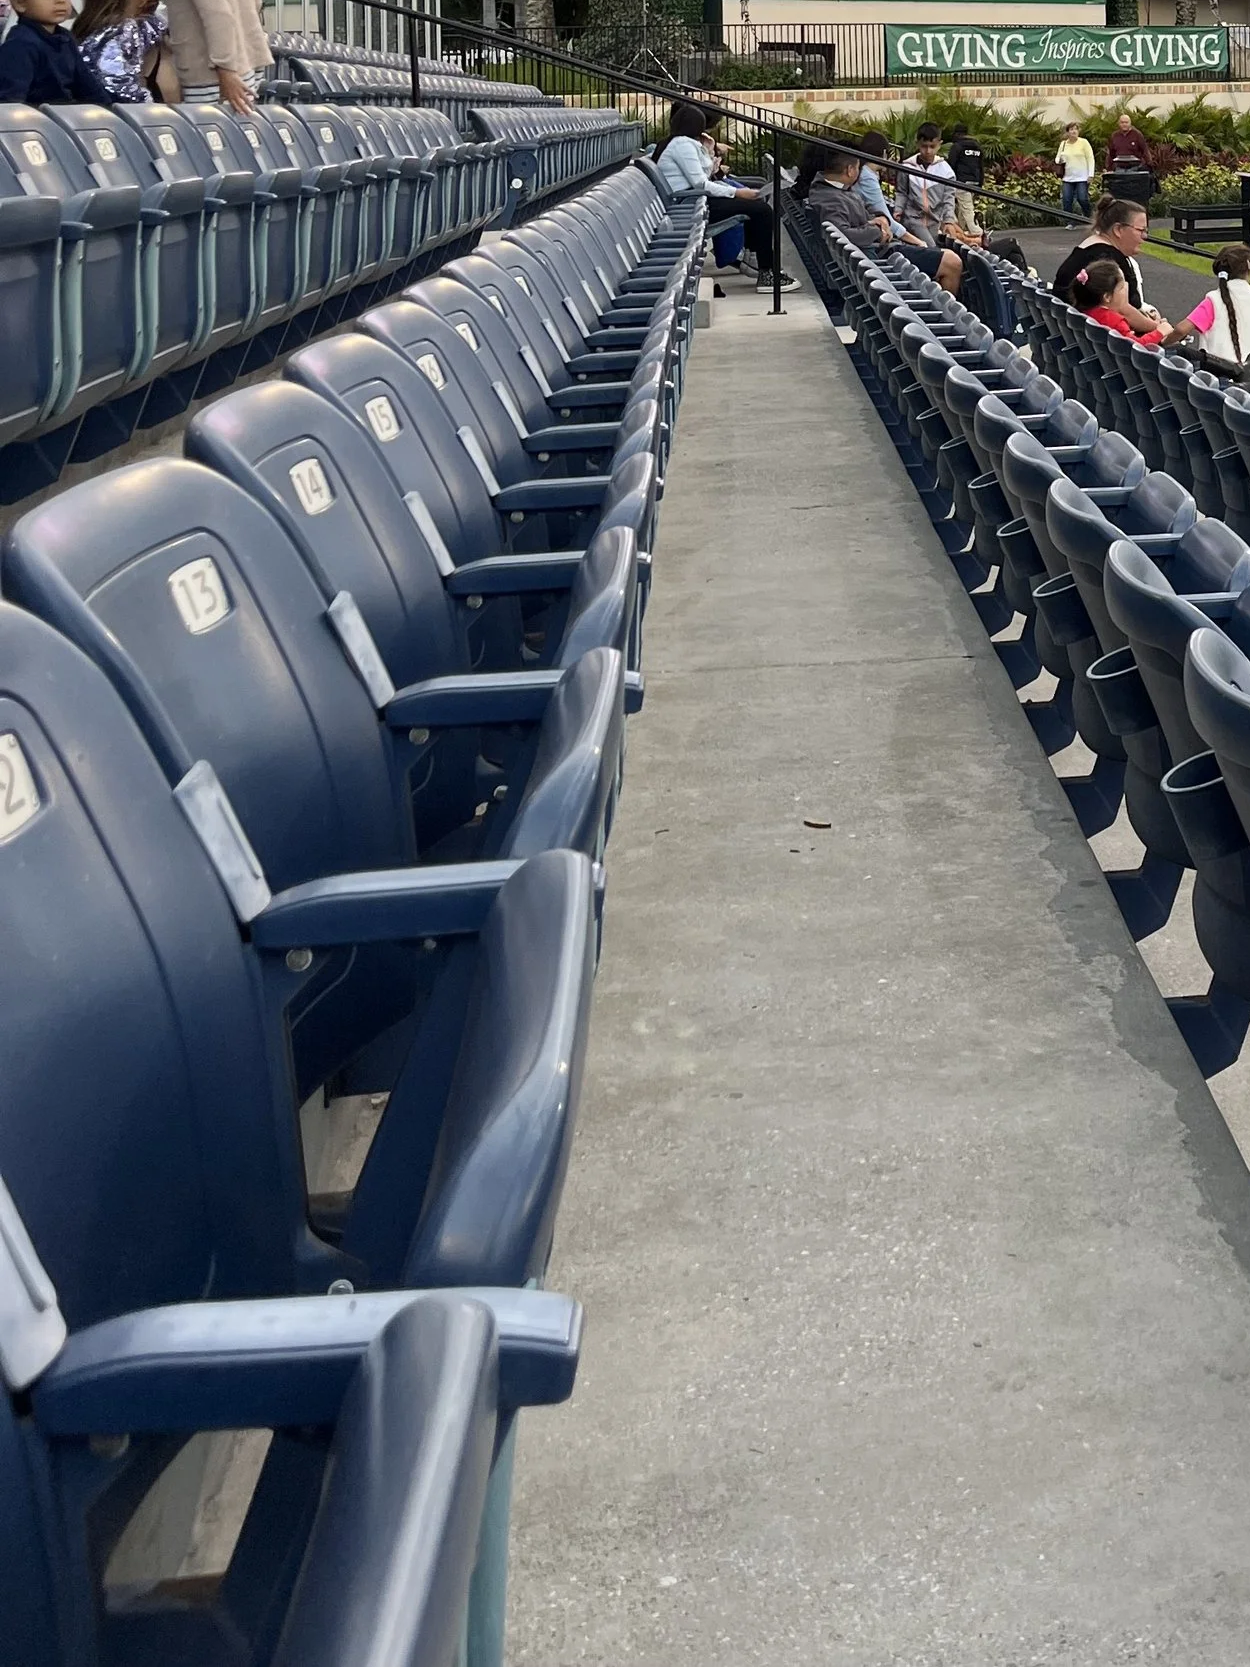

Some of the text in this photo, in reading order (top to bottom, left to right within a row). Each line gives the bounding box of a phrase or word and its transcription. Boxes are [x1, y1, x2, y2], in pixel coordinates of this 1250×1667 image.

[897, 29, 1221, 71] GIVING Inspires GIVING
[370, 404, 394, 431] 15
[296, 467, 323, 505] 14
[177, 570, 218, 621] 13
